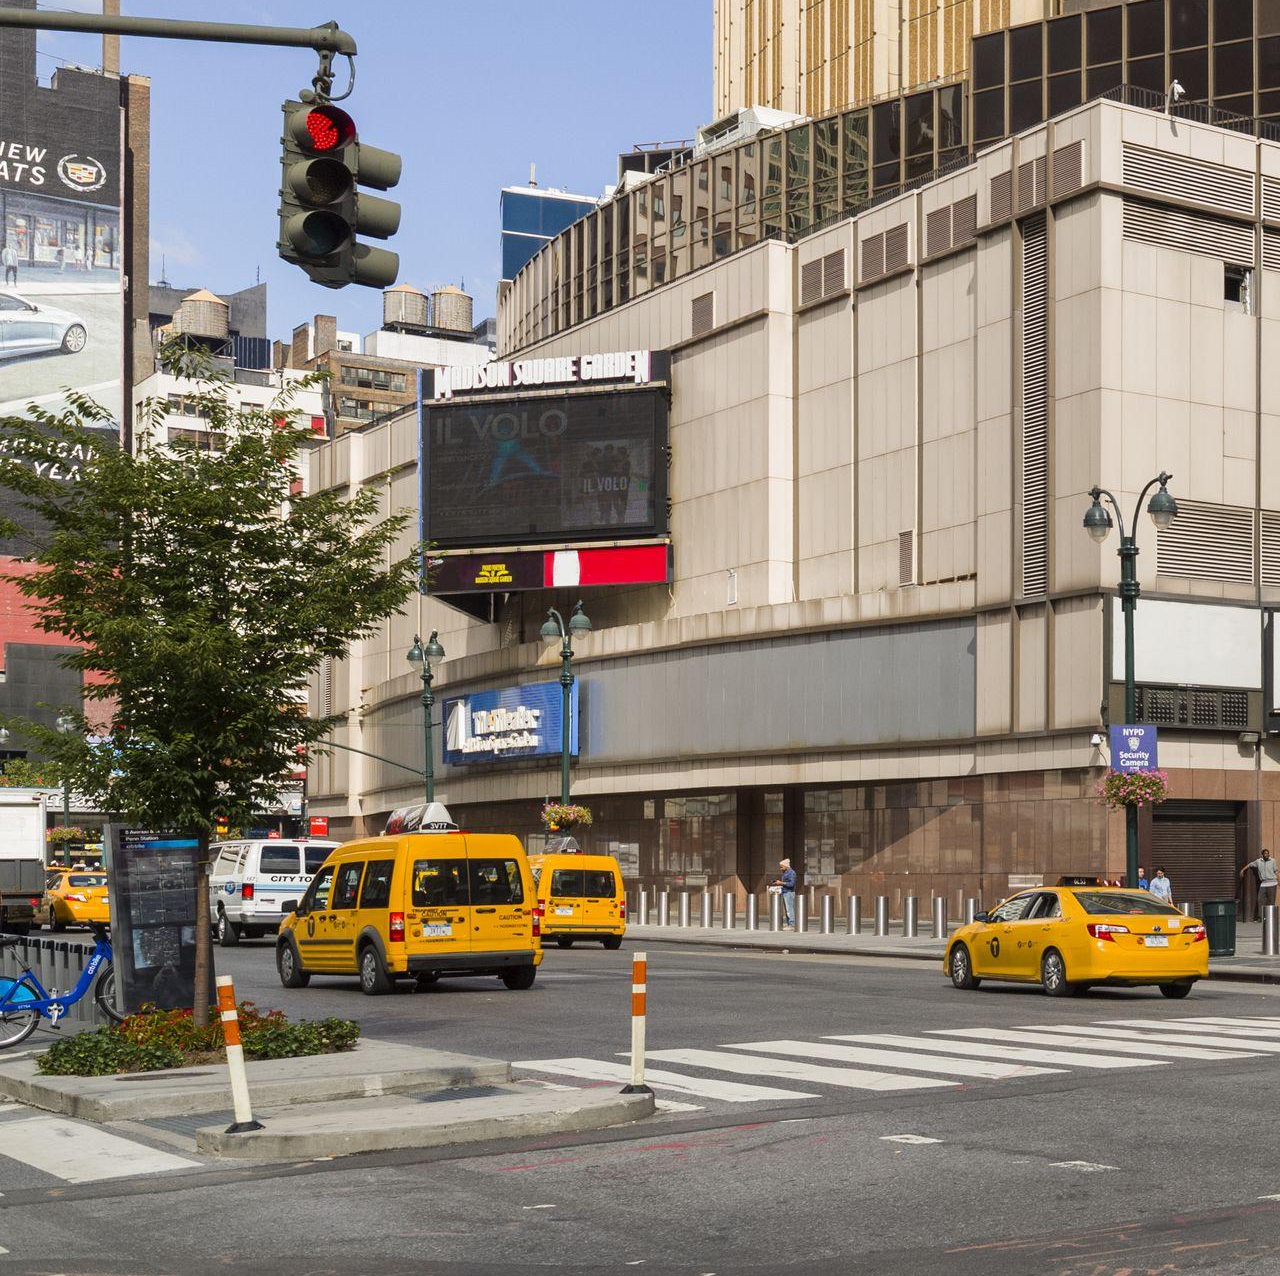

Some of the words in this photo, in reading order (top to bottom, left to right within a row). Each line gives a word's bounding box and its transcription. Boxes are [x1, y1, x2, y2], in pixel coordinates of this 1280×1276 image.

[434, 362, 513, 399] MADISON
[513, 356, 579, 386] SQUARE
[580, 350, 651, 384] GARDEN
[436, 417, 464, 445] IL
[470, 409, 568, 441] VOLO
[598, 476, 628, 492] VOLO
[1122, 728, 1145, 736] NYPD
[1119, 750, 1149, 760] Security
[1120, 758, 1149, 767] Camera
[271, 875, 295, 883] CITY
[298, 875, 334, 884] TORS
